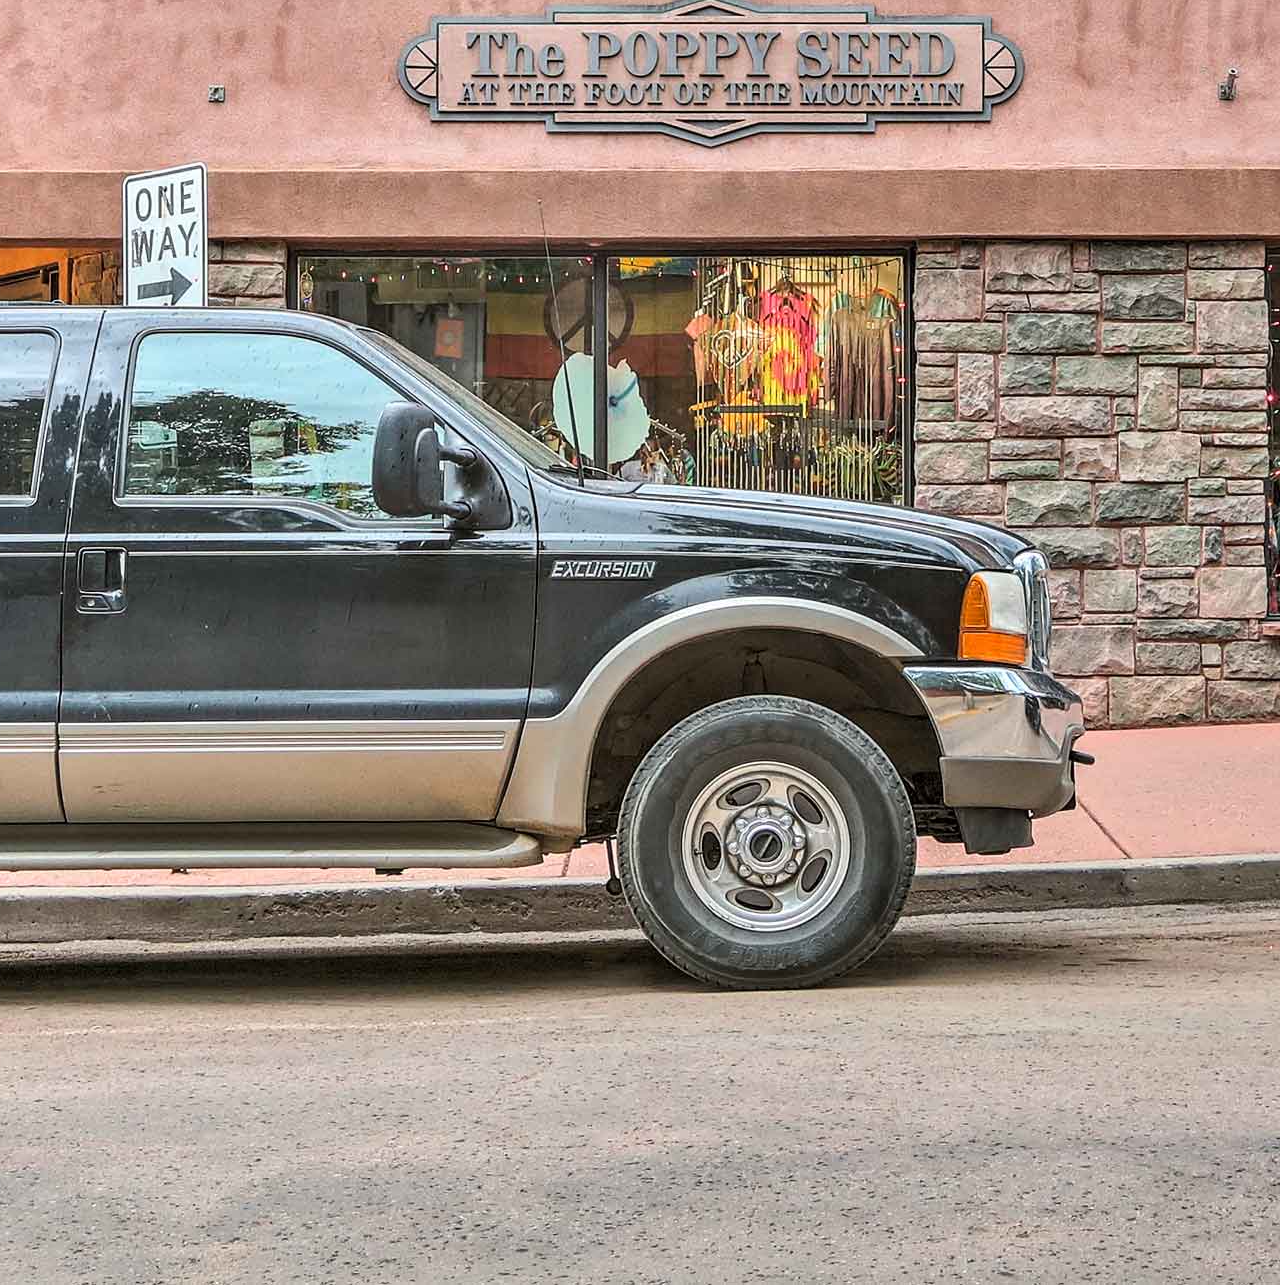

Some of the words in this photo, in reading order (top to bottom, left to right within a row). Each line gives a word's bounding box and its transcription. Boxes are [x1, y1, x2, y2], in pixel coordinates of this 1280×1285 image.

[466, 31, 566, 78] The
[581, 31, 782, 78] POPPY
[797, 31, 956, 78] SEED
[457, 82, 500, 106] AT
[508, 82, 576, 106] THE
[584, 82, 666, 106] FOOT
[673, 82, 716, 106] OF
[724, 82, 792, 106] THE
[799, 82, 964, 106] MOUNTAIN
[135, 179, 196, 222] ONE
[131, 221, 197, 268] WAY
[551, 560, 657, 578] EXCURSION
